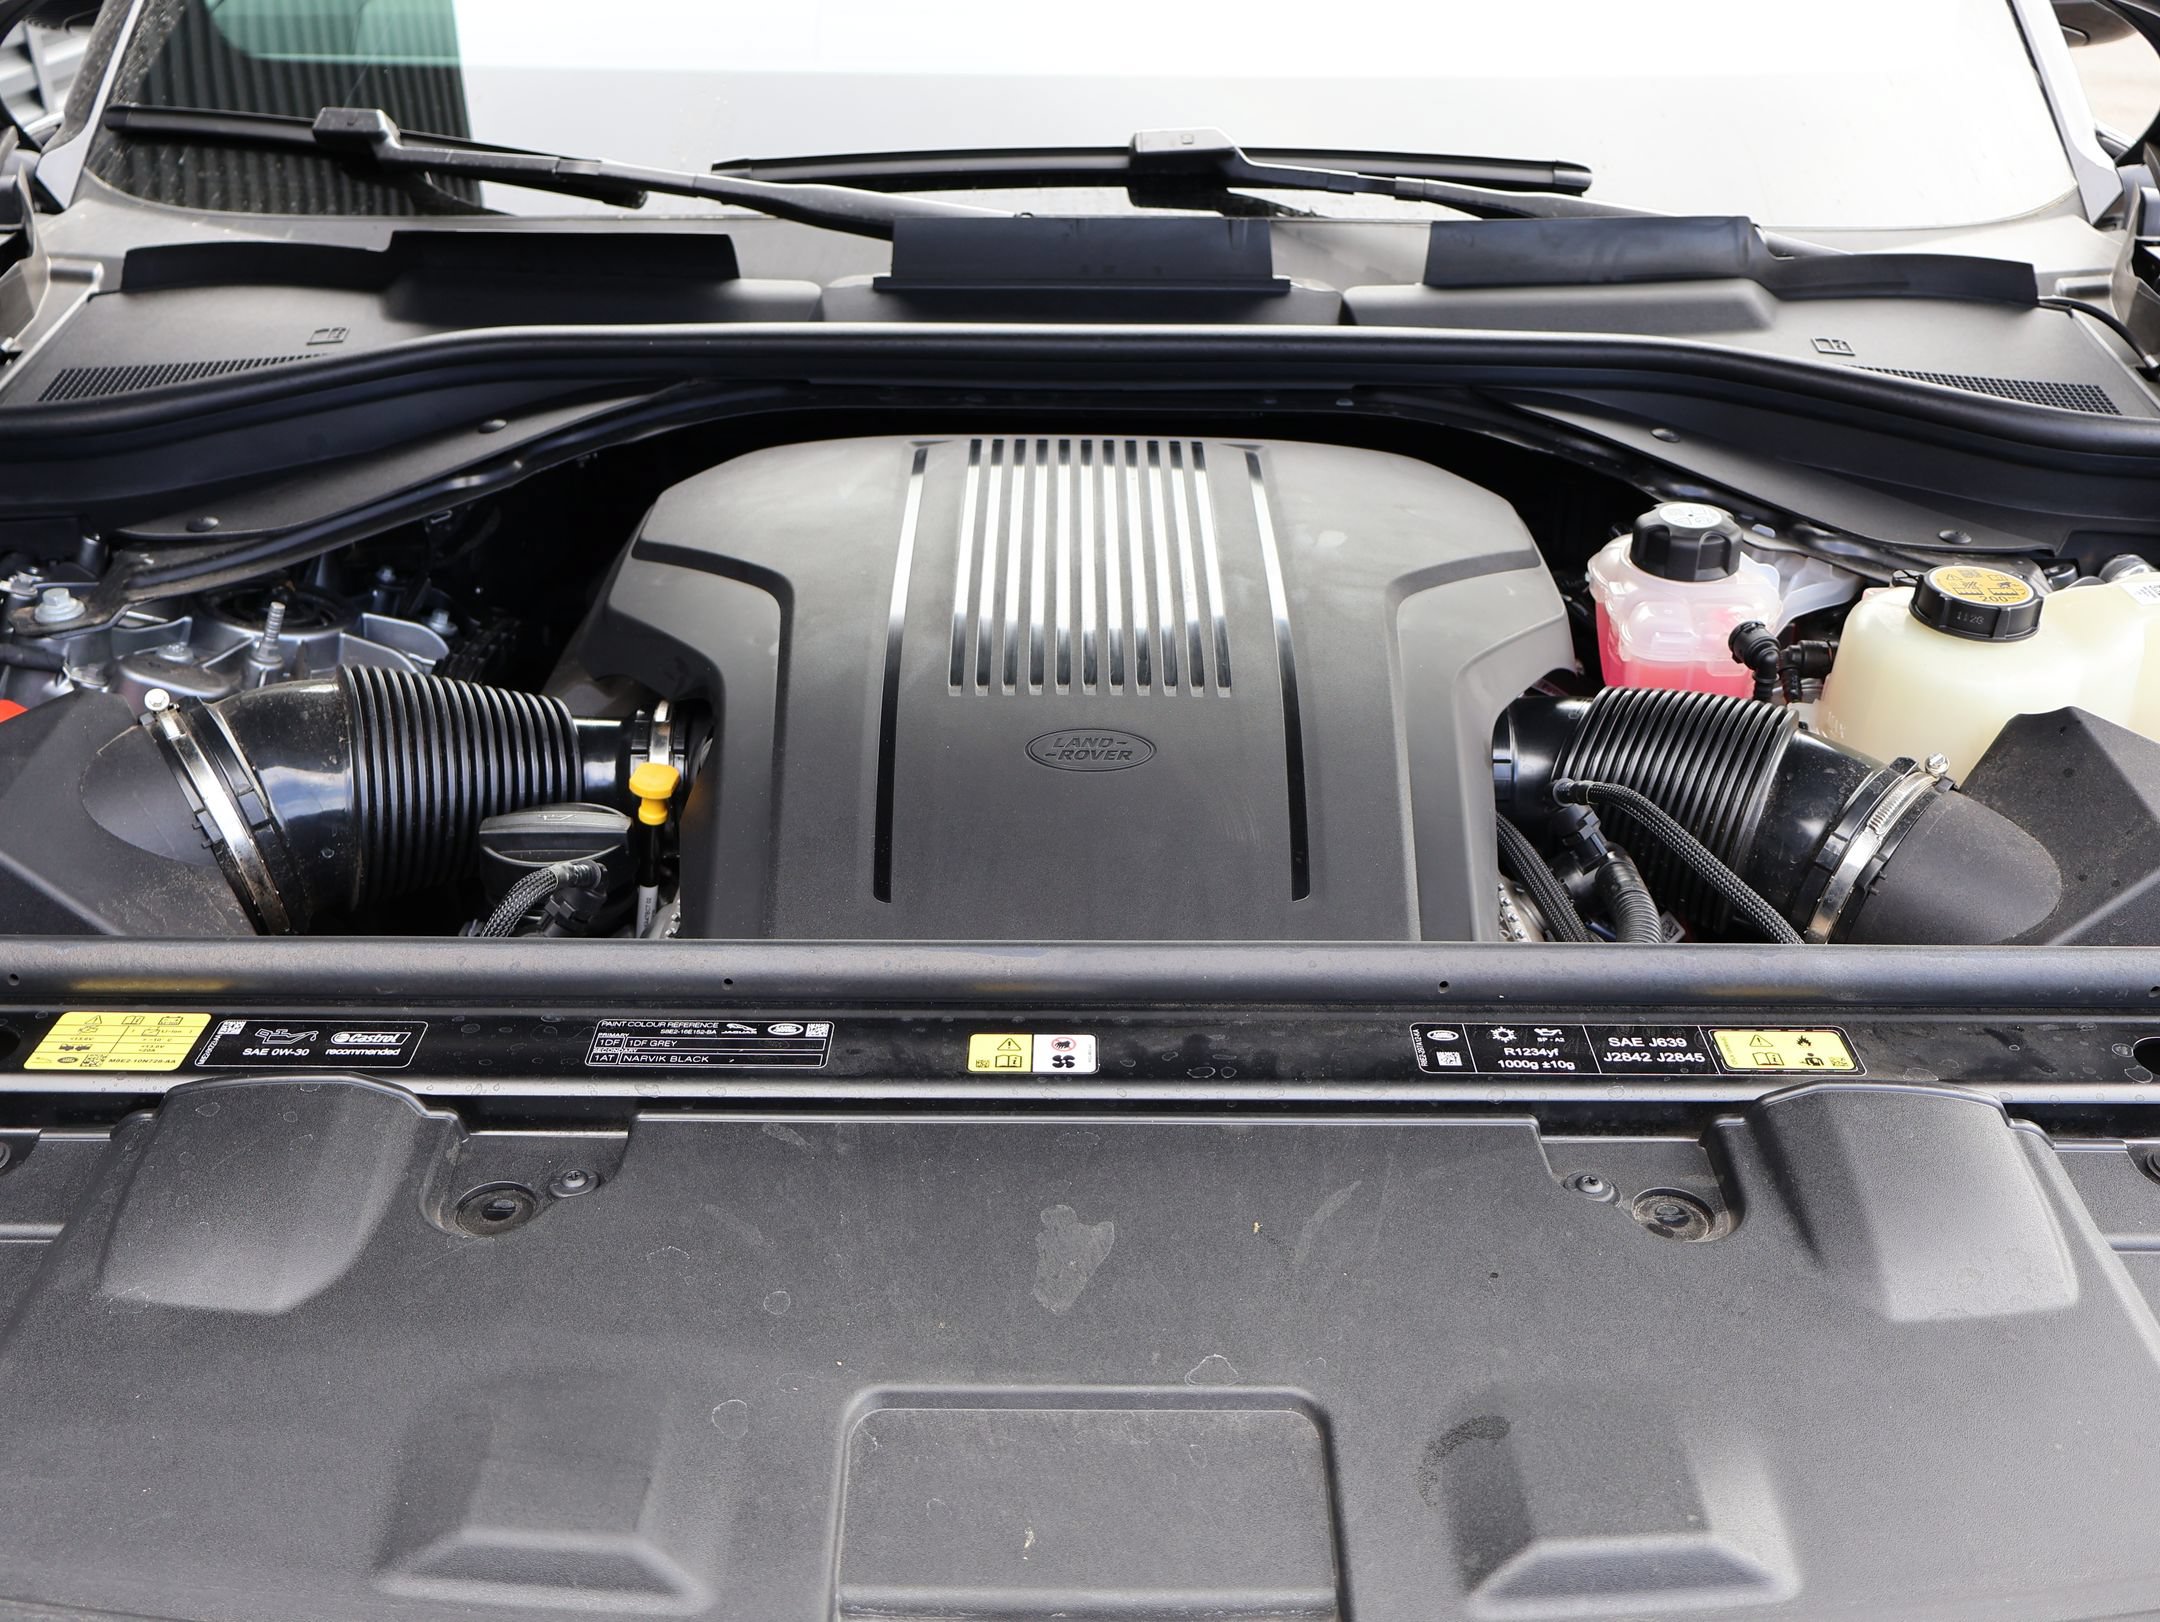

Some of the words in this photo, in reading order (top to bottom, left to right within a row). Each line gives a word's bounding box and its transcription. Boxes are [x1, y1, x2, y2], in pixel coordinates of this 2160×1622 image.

[1053, 737, 1113, 748] LAND
[1058, 750, 1133, 761] ROVER
[667, 1021, 719, 1029] REFERENCE
[349, 1033, 400, 1043] Castrol
[600, 1039, 620, 1047] 1DF
[1608, 1037, 1645, 1047] SAE
[1648, 1037, 1688, 1048] J639
[242, 1048, 270, 1056] SAE
[271, 1048, 310, 1056] 0W-30
[325, 1048, 401, 1056] recommended
[1503, 1047, 1559, 1058] R1234yf
[623, 1055, 666, 1063] NARVIK
[1603, 1052, 1653, 1063] J2842
[1656, 1052, 1706, 1063] J2845
[1497, 1060, 1540, 1070] 1000g
[1541, 1060, 1576, 1071] ±10g
